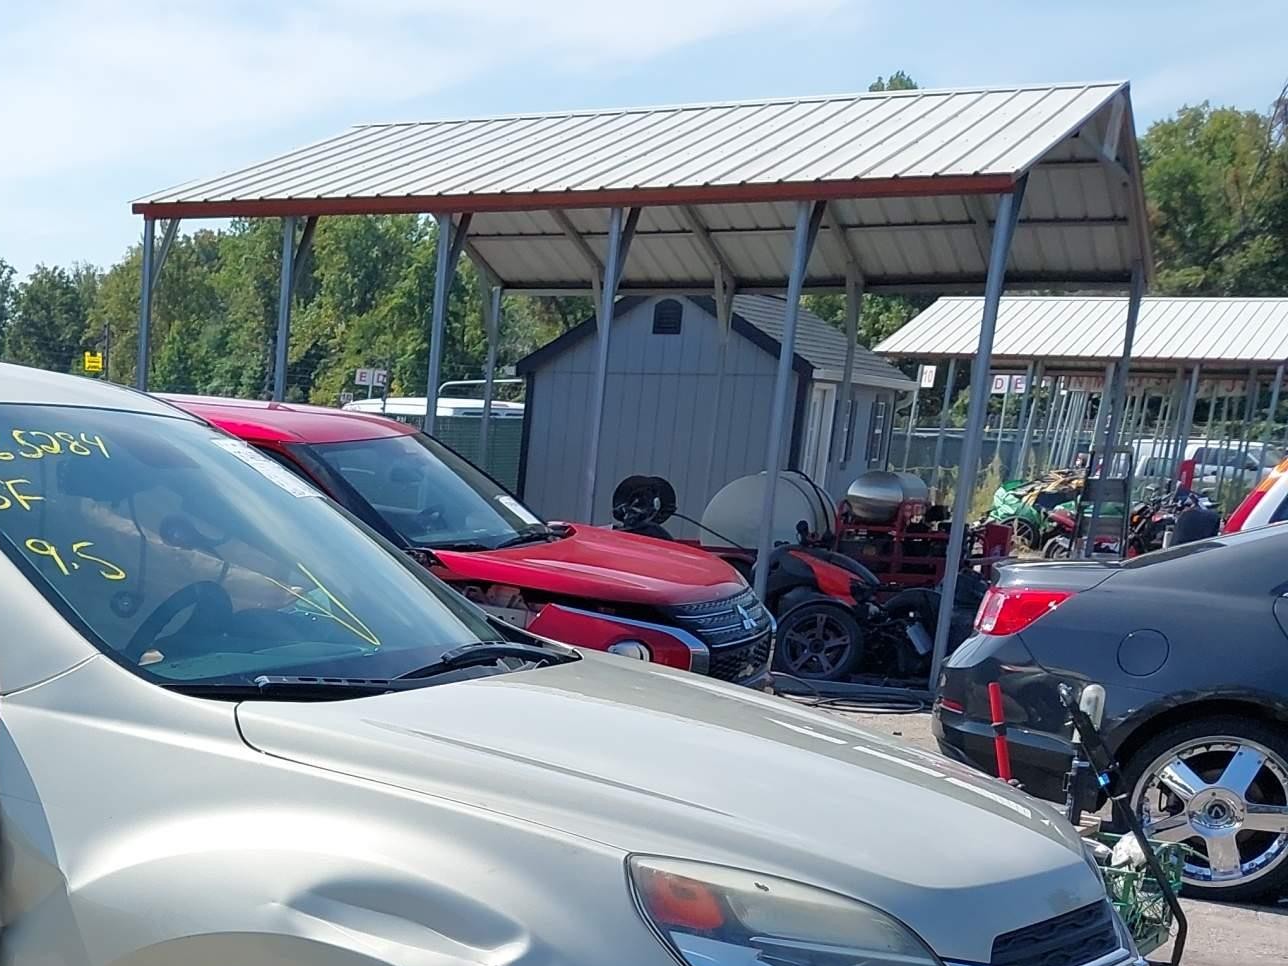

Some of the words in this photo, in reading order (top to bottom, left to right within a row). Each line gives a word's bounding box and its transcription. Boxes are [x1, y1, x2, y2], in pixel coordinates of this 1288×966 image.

[359, 371, 367, 383] E
[923, 369, 934, 384] 10
[994, 377, 1004, 390] D
[1015, 378, 1024, 390] E
[25, 538, 126, 580] 9.5
